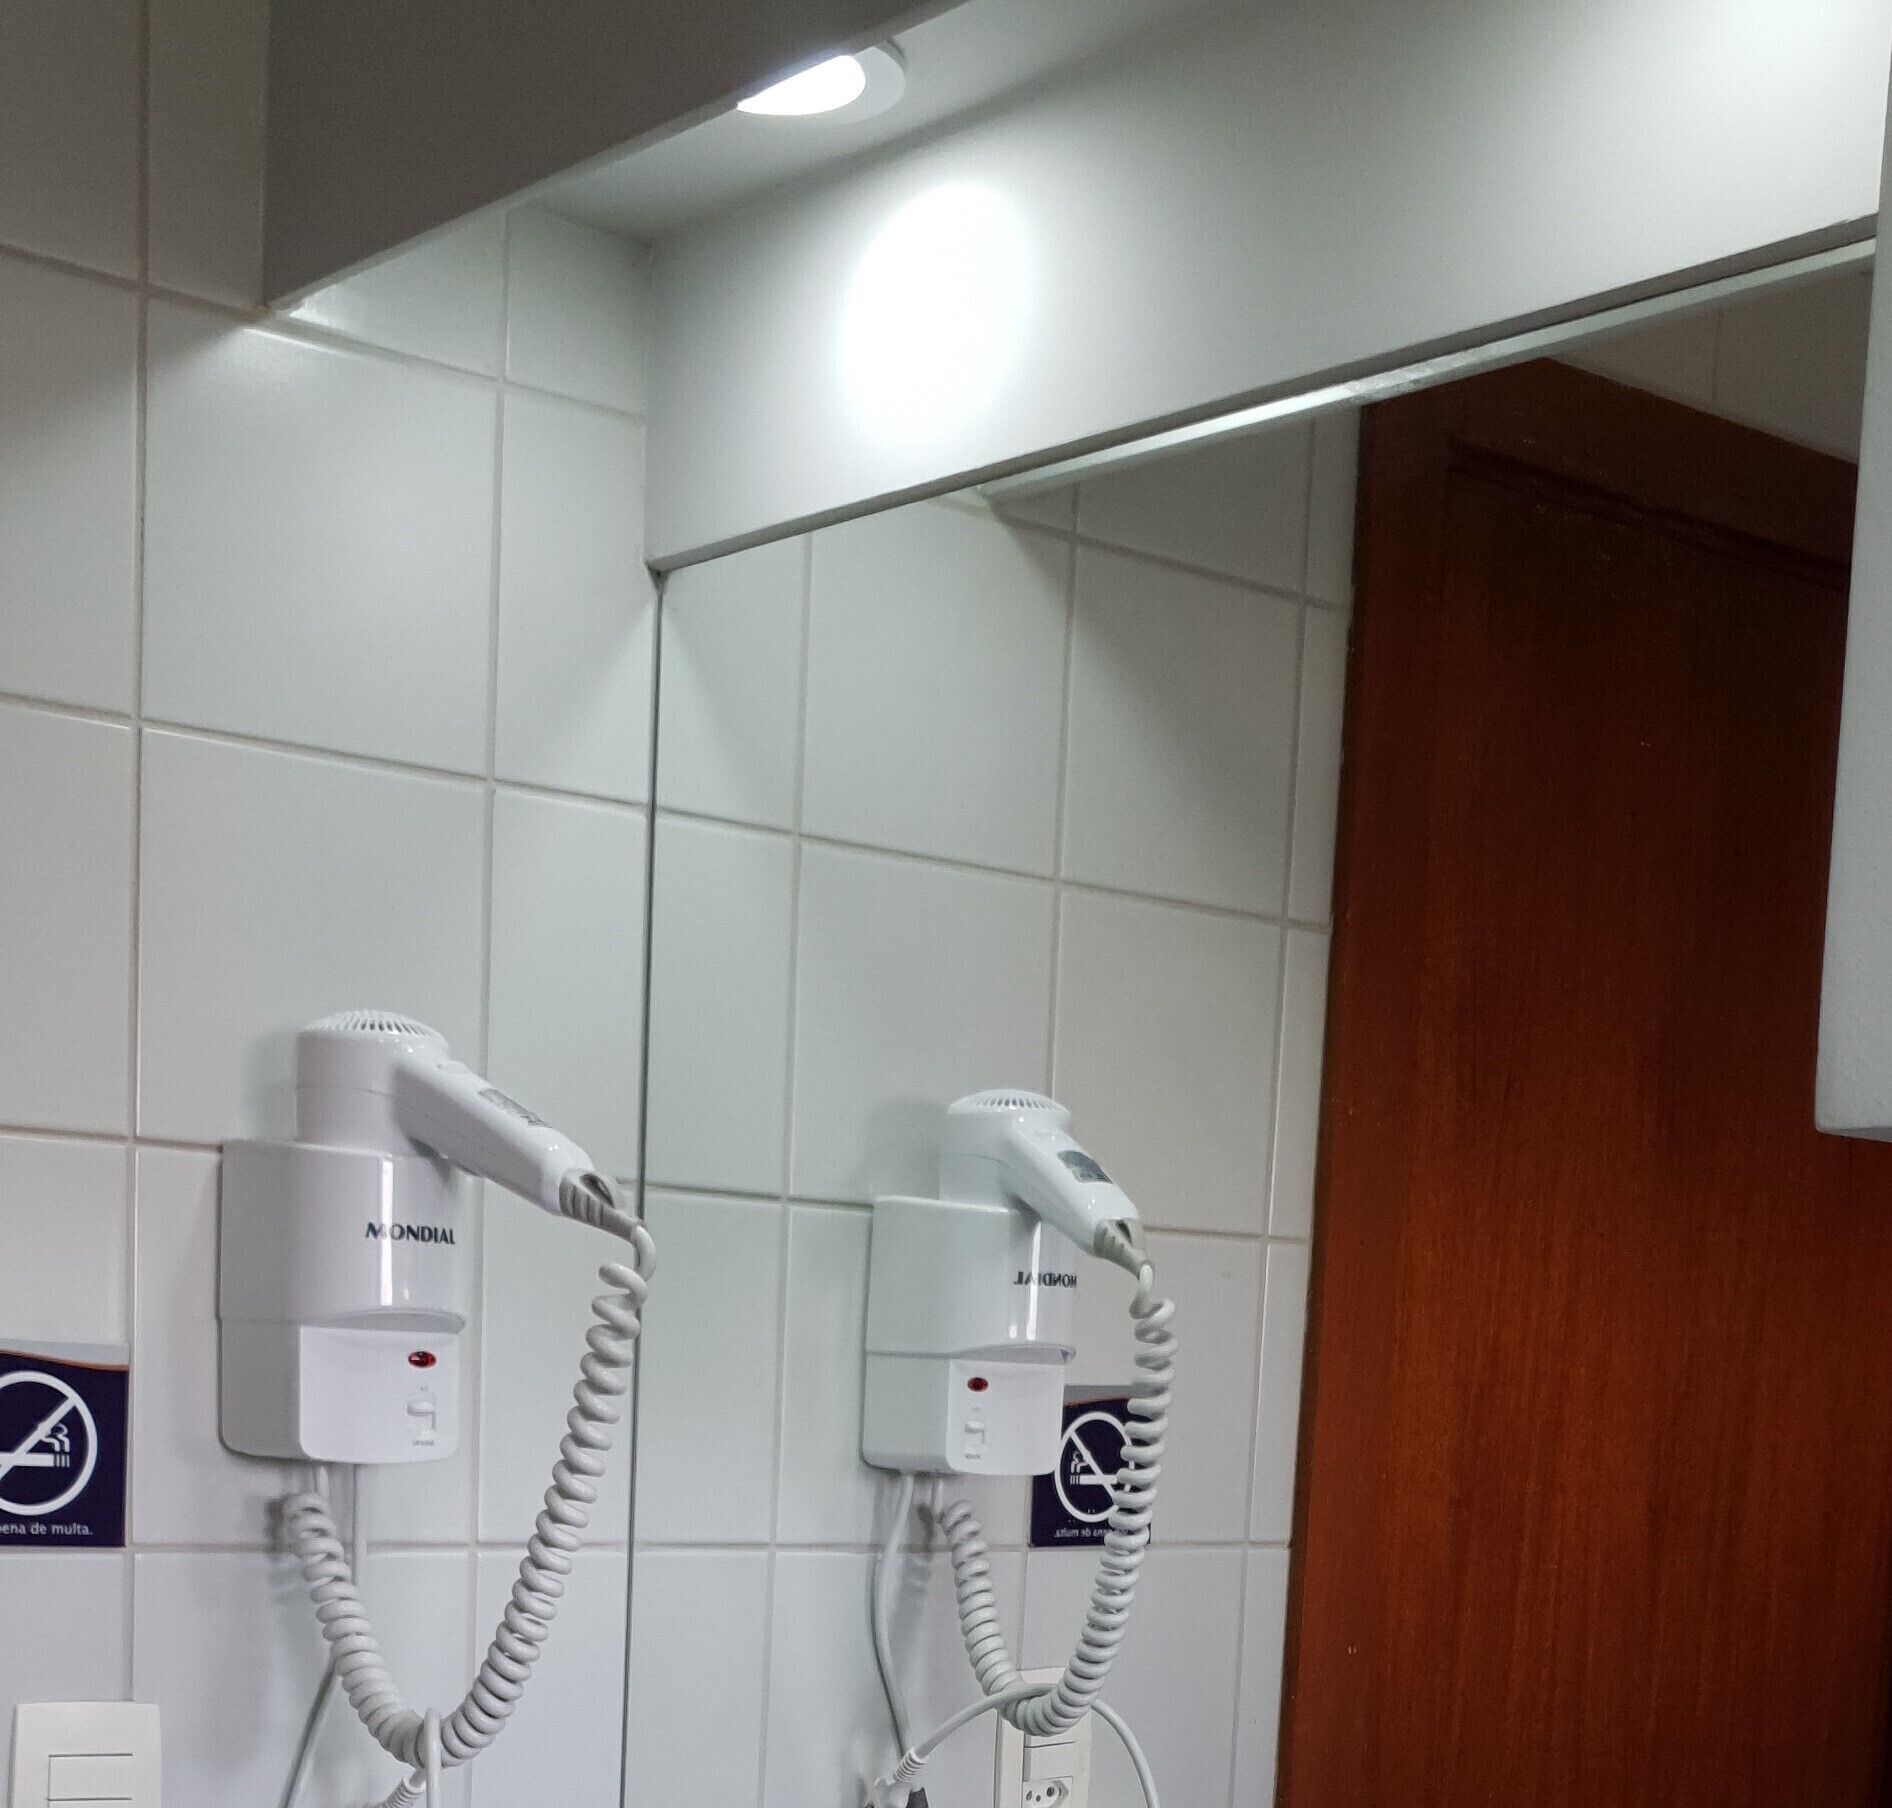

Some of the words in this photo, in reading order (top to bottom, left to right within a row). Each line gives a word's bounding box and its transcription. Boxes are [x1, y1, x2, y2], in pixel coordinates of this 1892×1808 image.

[364, 1221, 456, 1246] MONDIAL
[0, 1523, 27, 1535] ena
[30, 1521, 48, 1536] de
[51, 1522, 94, 1537] multa.
